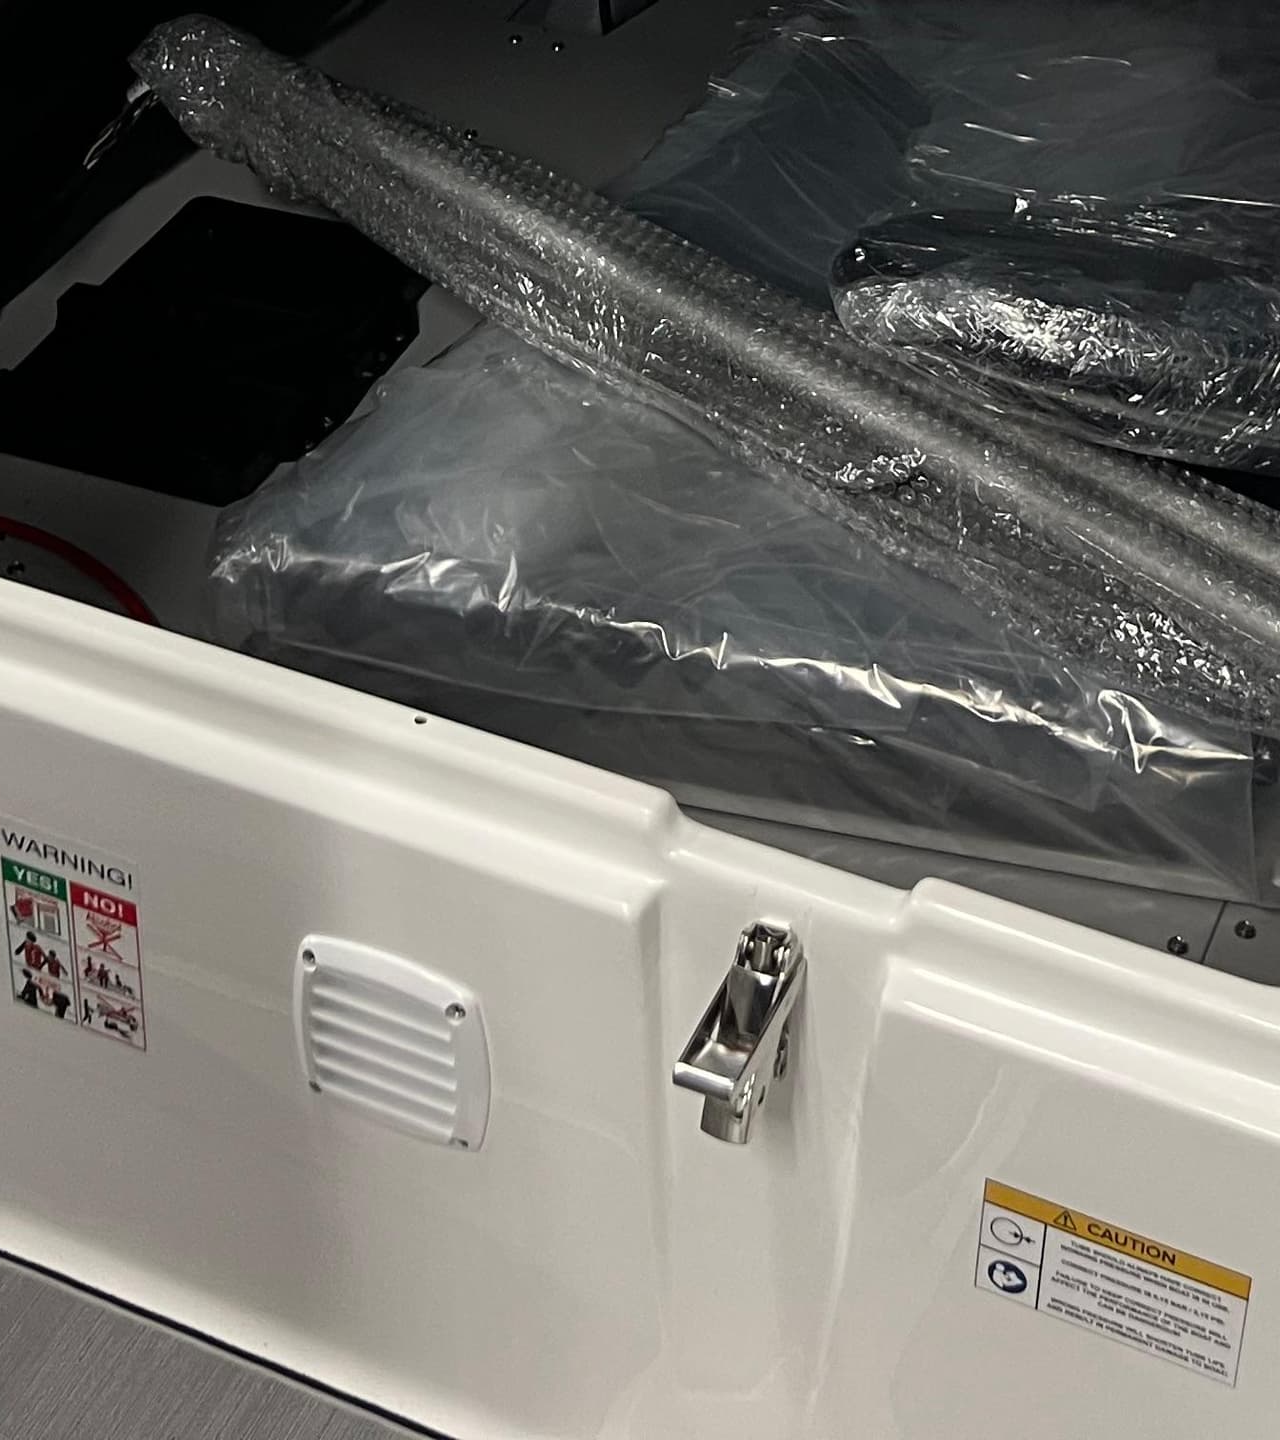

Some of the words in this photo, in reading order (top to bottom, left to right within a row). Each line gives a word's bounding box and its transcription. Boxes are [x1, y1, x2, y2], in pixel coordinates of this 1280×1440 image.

[1, 827, 133, 891] WARNING!
[13, 865, 58, 894] YES!
[83, 891, 123, 918] NO!
[1087, 1222, 1176, 1266] CAUTION
